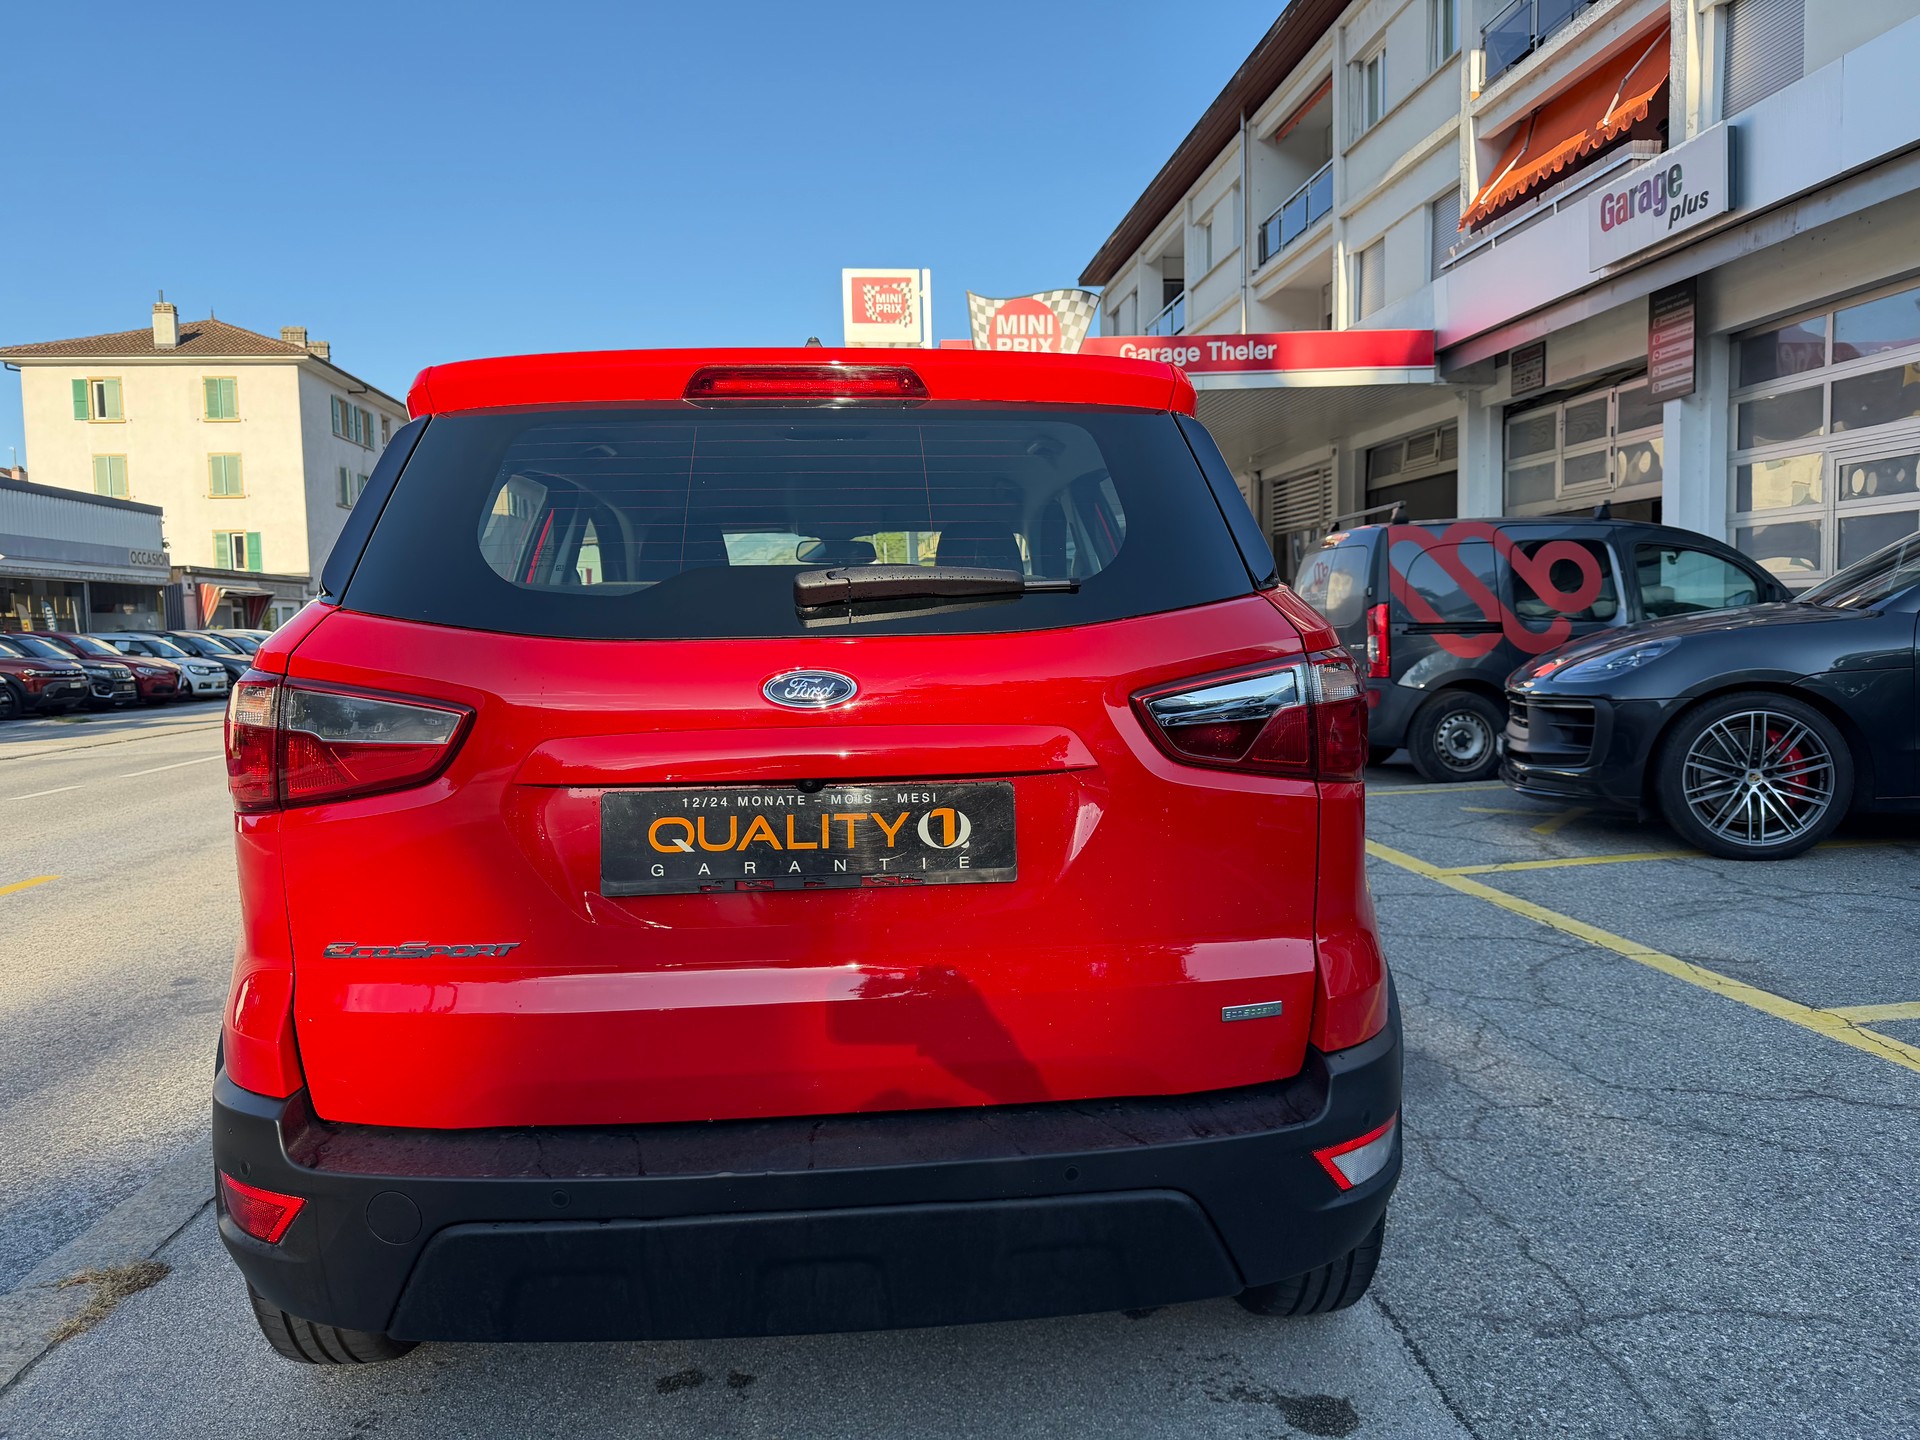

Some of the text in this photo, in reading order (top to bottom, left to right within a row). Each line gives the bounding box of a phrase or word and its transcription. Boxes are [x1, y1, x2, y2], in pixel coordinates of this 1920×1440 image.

[1601, 163, 1682, 232] Garage
[1668, 190, 1709, 230] plus
[876, 293, 902, 303] MINI
[876, 303, 902, 314] PRIX
[996, 314, 1054, 335] MINI
[1119, 340, 1277, 367] Garage Theler
[784, 678, 836, 700] Ford
[682, 797, 728, 808] 12/24
[737, 795, 806, 807] MONATE
[830, 793, 872, 805] MOIS
[897, 792, 936, 803] MESI
[648, 811, 911, 853] QUALITY
[650, 856, 971, 877] GARANTIE
